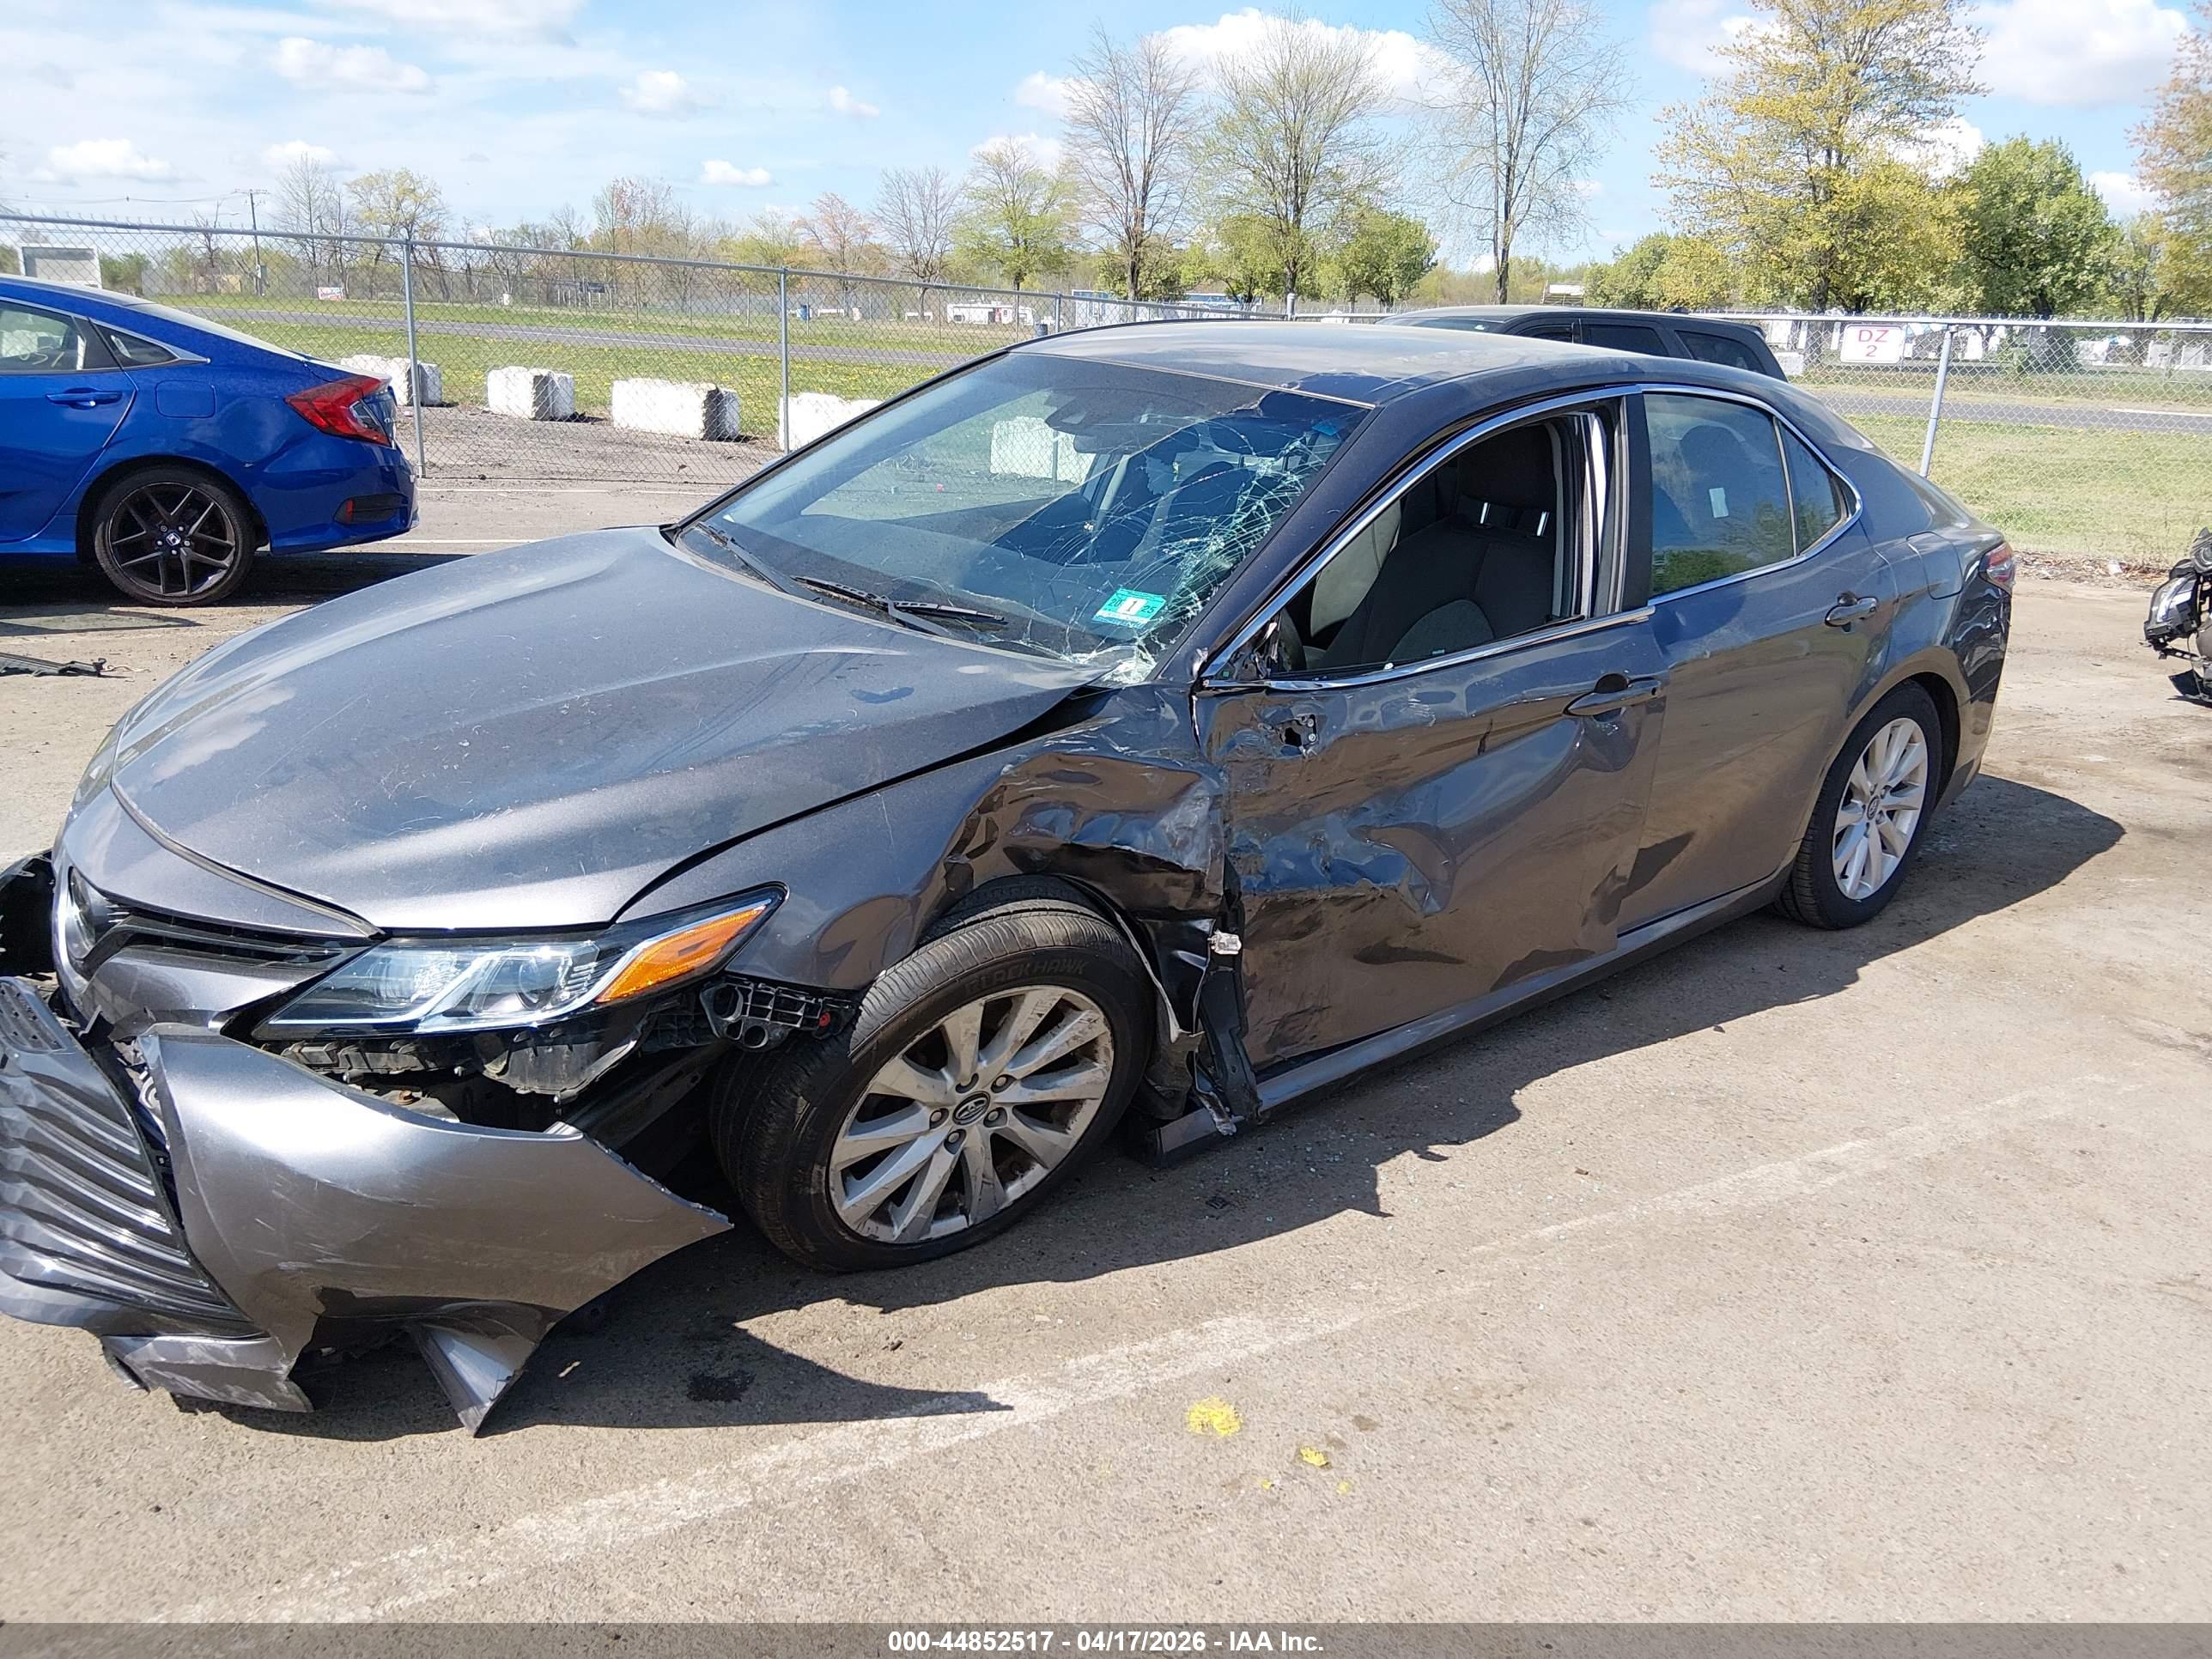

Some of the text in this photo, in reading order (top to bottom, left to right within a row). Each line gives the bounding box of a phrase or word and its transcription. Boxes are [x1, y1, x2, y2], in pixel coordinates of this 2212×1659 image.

[1858, 329, 1889, 343] DZ
[1865, 344, 1877, 357] 2
[1139, 605, 1157, 614] 25
